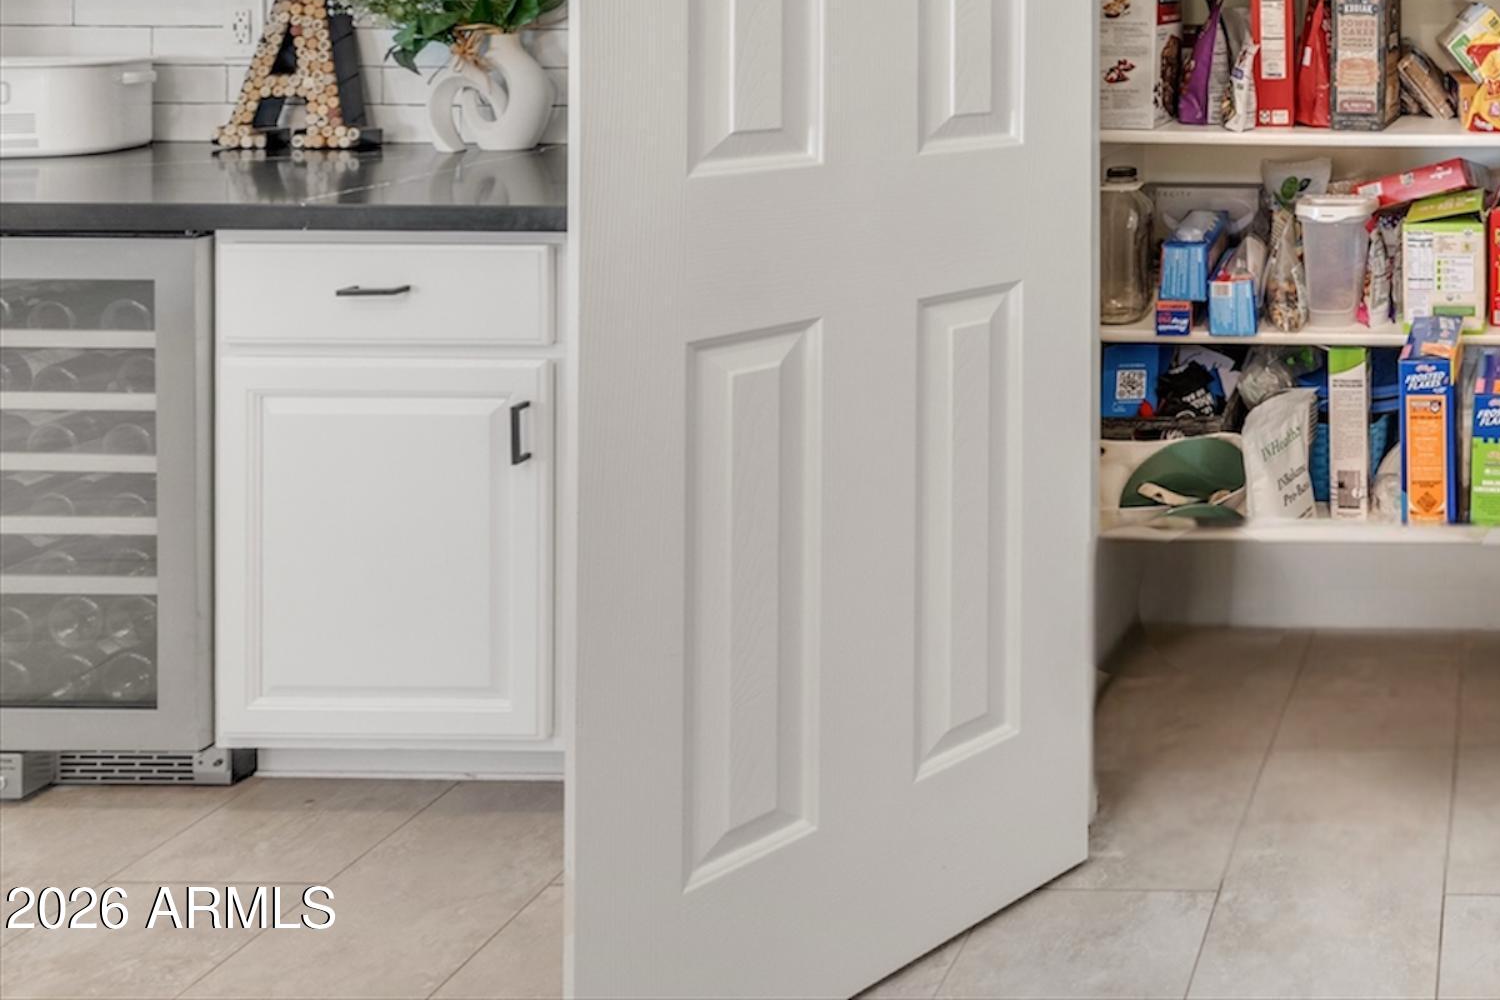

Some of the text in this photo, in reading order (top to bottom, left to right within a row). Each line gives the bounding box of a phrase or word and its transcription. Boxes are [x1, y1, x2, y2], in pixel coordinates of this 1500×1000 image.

[1344, 3, 1373, 14] KODIAK
[1341, 19, 1376, 27] POWER
[1342, 27, 1376, 36] CAKES
[1405, 371, 1446, 384] FROSTED
[1407, 379, 1441, 392] FLAKES
